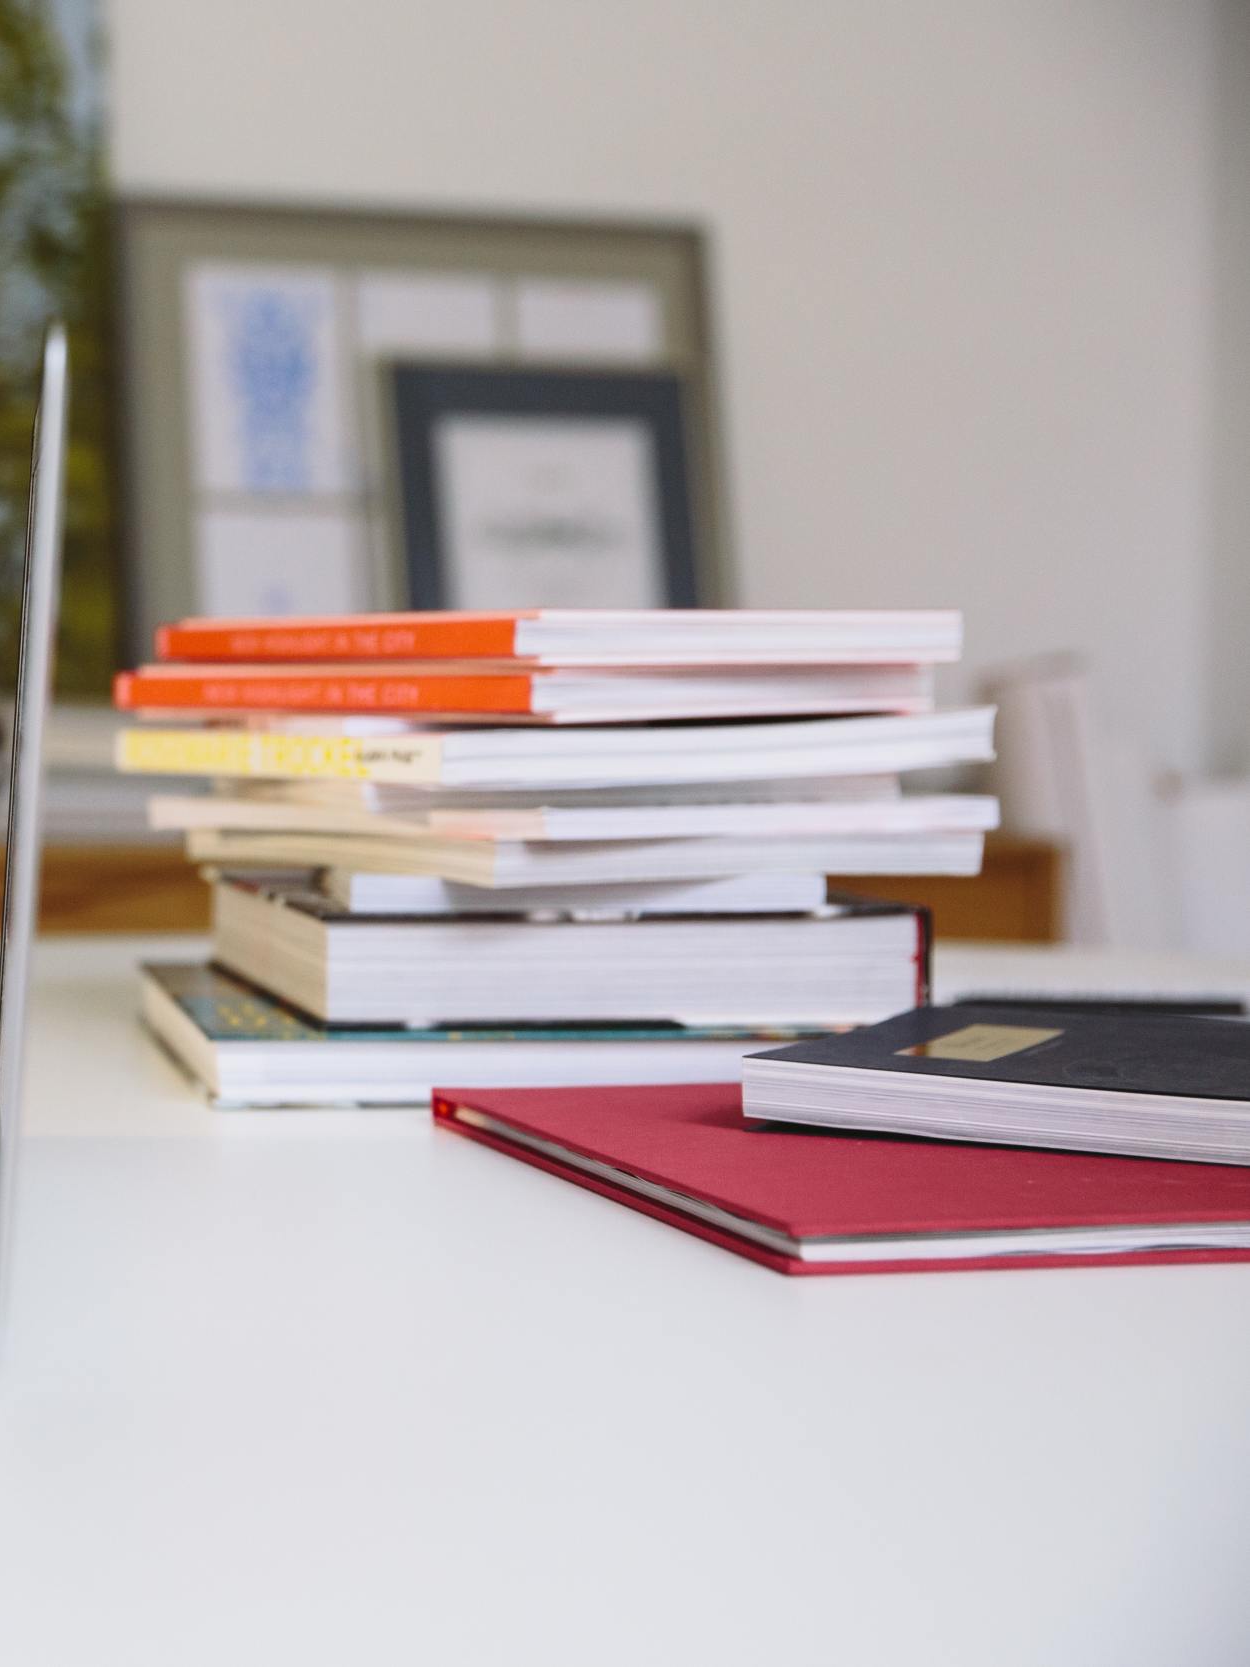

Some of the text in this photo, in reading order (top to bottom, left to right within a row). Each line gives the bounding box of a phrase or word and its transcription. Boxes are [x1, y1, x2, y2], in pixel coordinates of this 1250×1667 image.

[381, 630, 416, 653] CITY
[347, 682, 377, 705] THE
[380, 682, 419, 705] CITY
